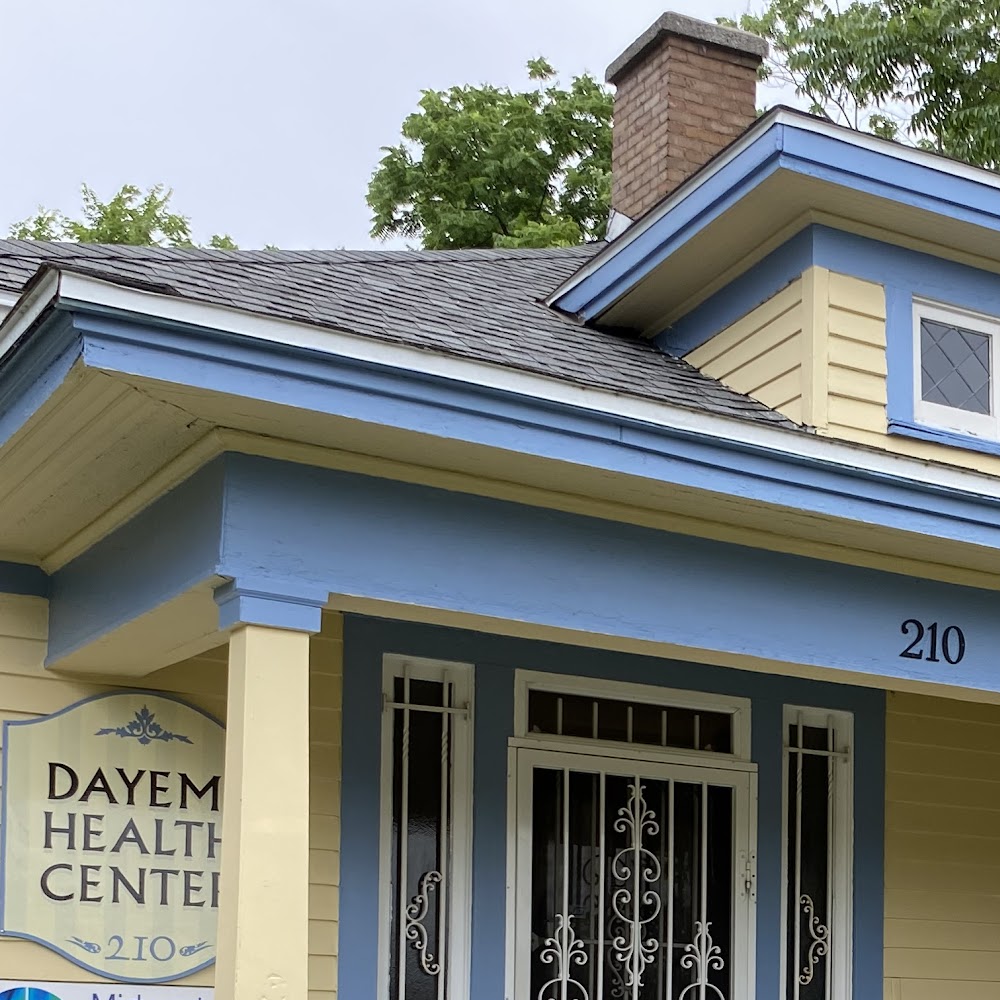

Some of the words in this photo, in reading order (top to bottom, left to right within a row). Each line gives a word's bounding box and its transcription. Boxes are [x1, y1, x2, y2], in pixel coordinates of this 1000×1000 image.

[899, 619, 966, 665] 210
[47, 762, 222, 811] DAYEM
[104, 935, 176, 961] 210
